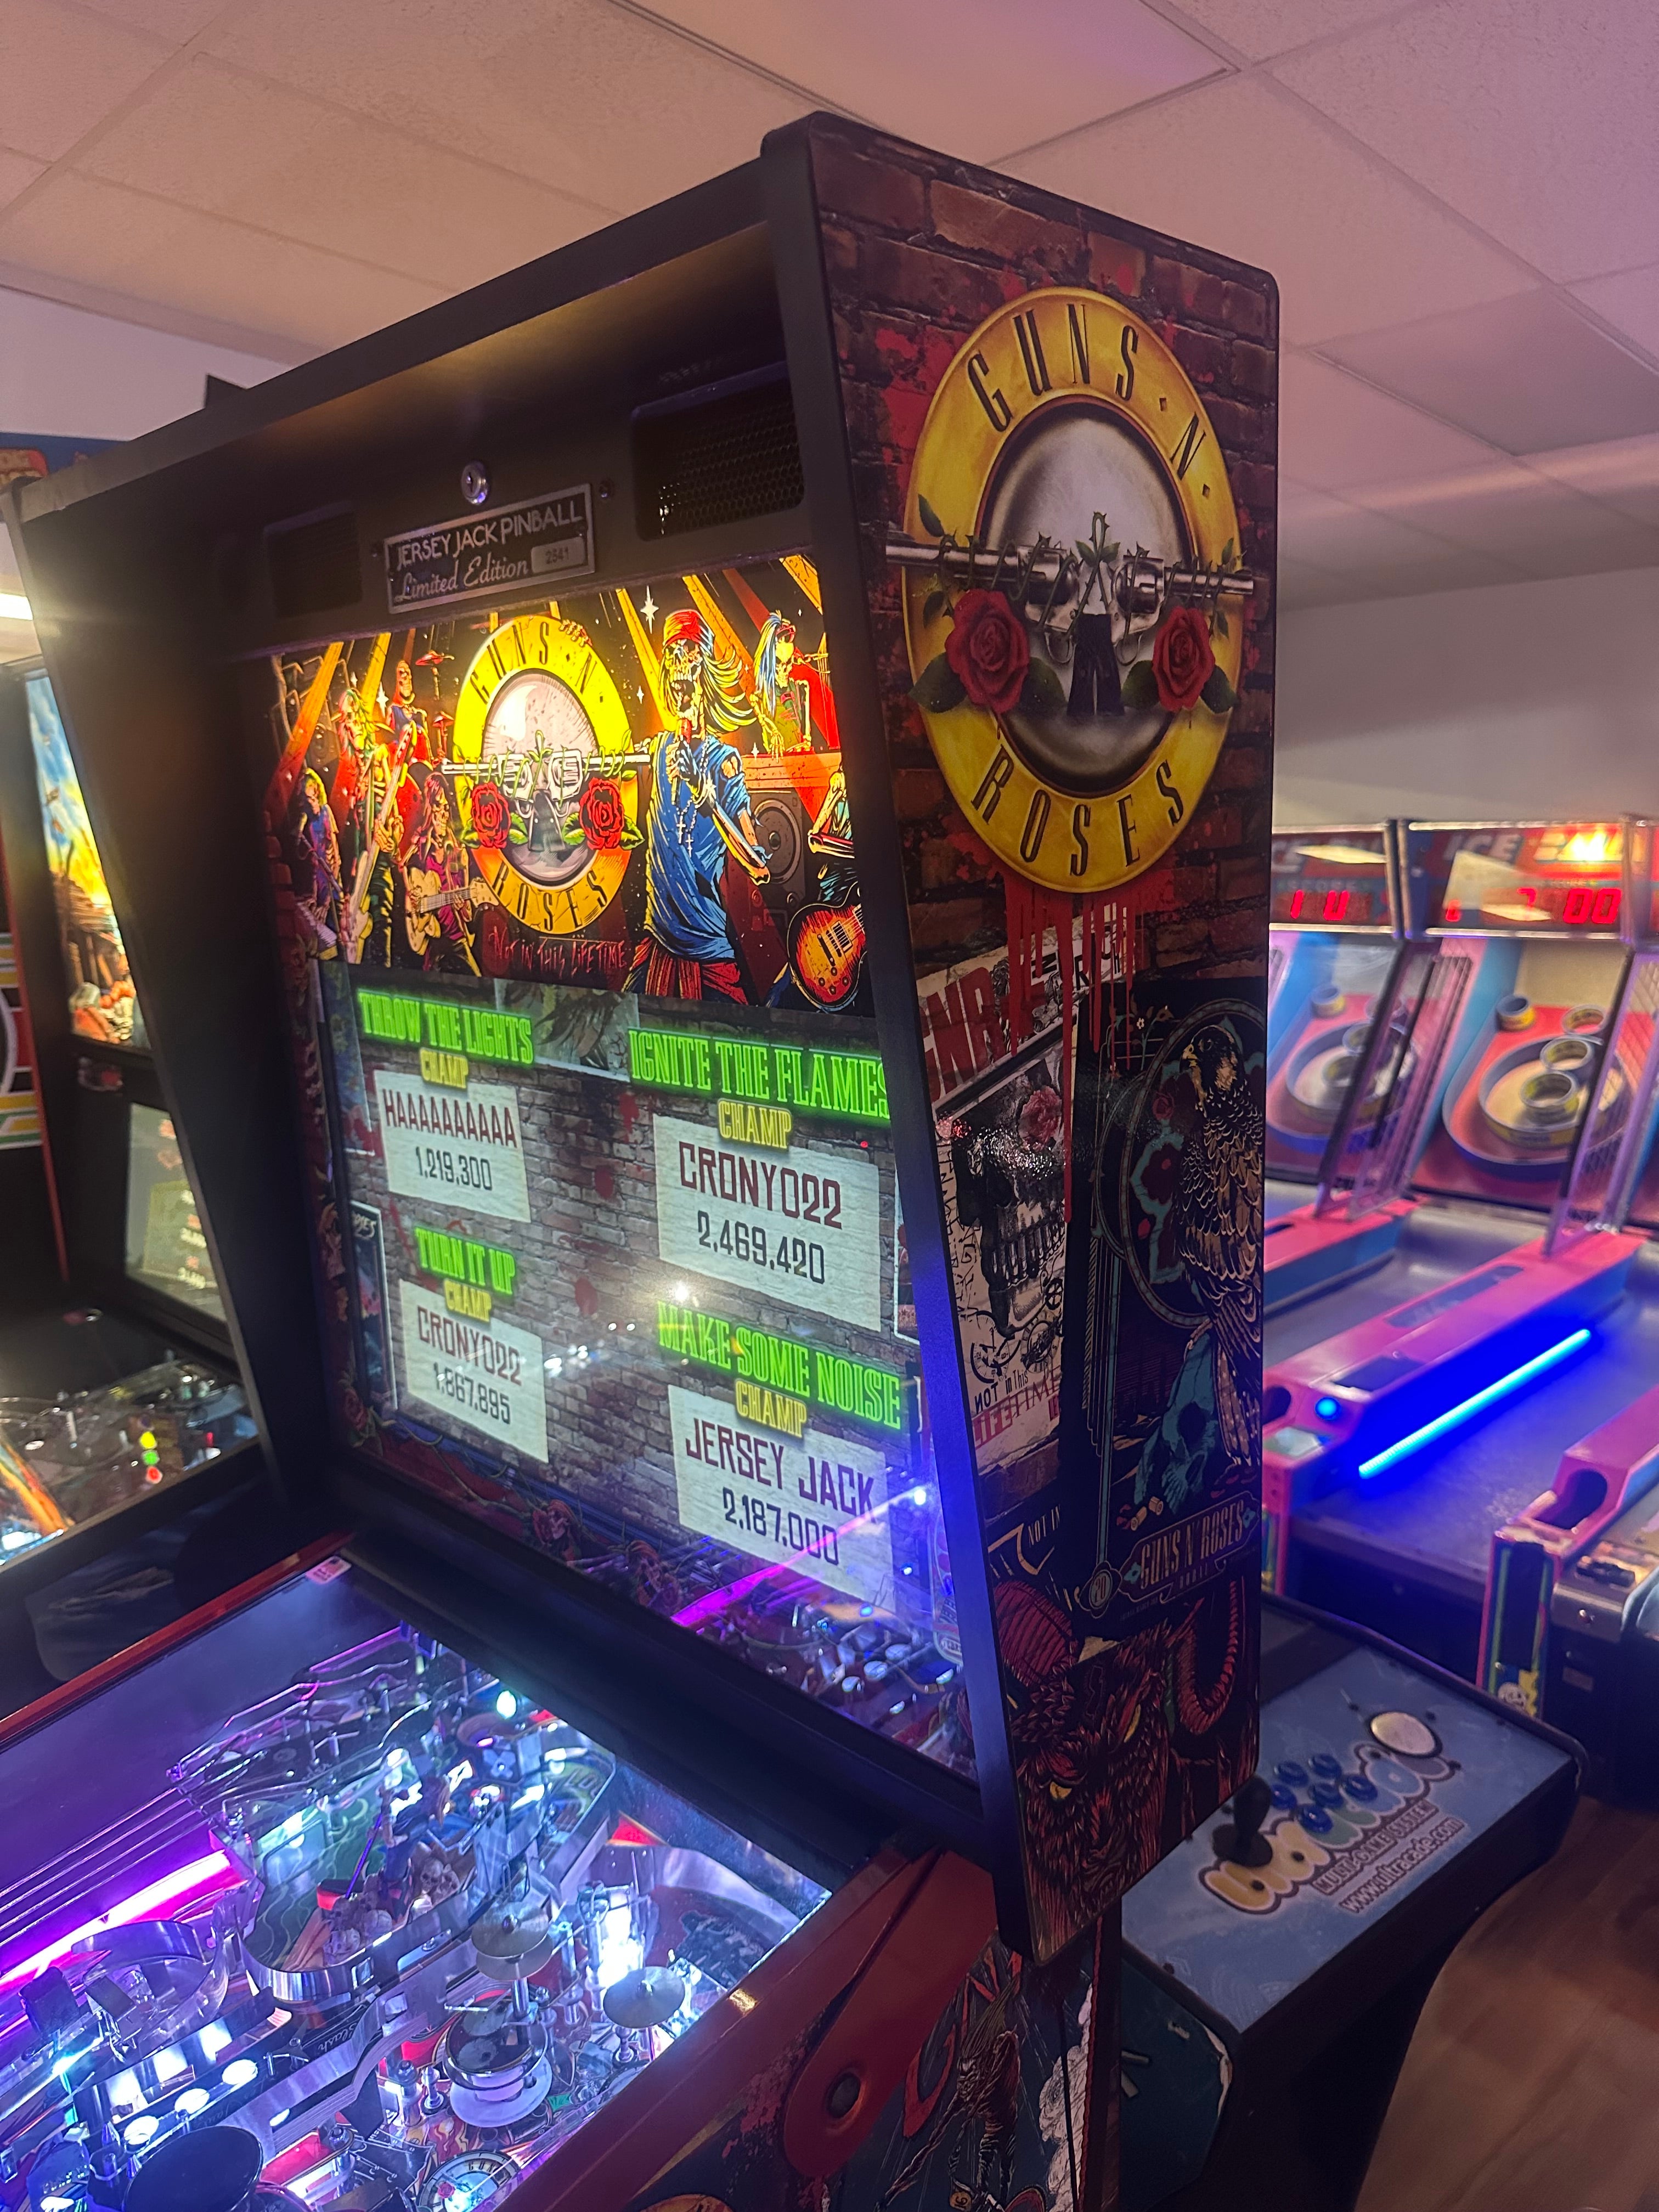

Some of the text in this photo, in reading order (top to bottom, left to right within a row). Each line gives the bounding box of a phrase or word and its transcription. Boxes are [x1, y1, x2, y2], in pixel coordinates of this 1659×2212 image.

[967, 303, 1139, 432] GUNS
[397, 500, 584, 571] JERSEY JACK PINBALL
[394, 560, 459, 602] Limited
[463, 552, 528, 587] Edition
[470, 622, 549, 705] GUNS
[970, 743, 1184, 877] ROSES
[492, 860, 608, 932] ROSES
[1562, 888, 1622, 924] 00
[358, 990, 534, 1064] THROW THE LIGHTS
[421, 1048, 469, 1090] CHAMP
[628, 1030, 890, 1120] IGNITE THE FLAMES
[718, 1099, 792, 1149] CHAMP
[415, 1227, 516, 1295] TURN IT UP
[697, 1210, 825, 1284] 2,469,420
[444, 1279, 492, 1322] CHAMP
[658, 1301, 901, 1430] MAKE SOME NOISE
[974, 1382, 998, 1415] NOT
[735, 1379, 807, 1438] CHAMP
[686, 1418, 876, 1523] JERSEY JACK
[723, 1486, 839, 1566] 2,187,000
[1028, 1513, 1047, 1548] NOT
[1139, 1528, 1182, 1590] GUNS
[1200, 1499, 1245, 1561] ROSES
[1339, 1816, 1465, 1914] www.ultracade.com
